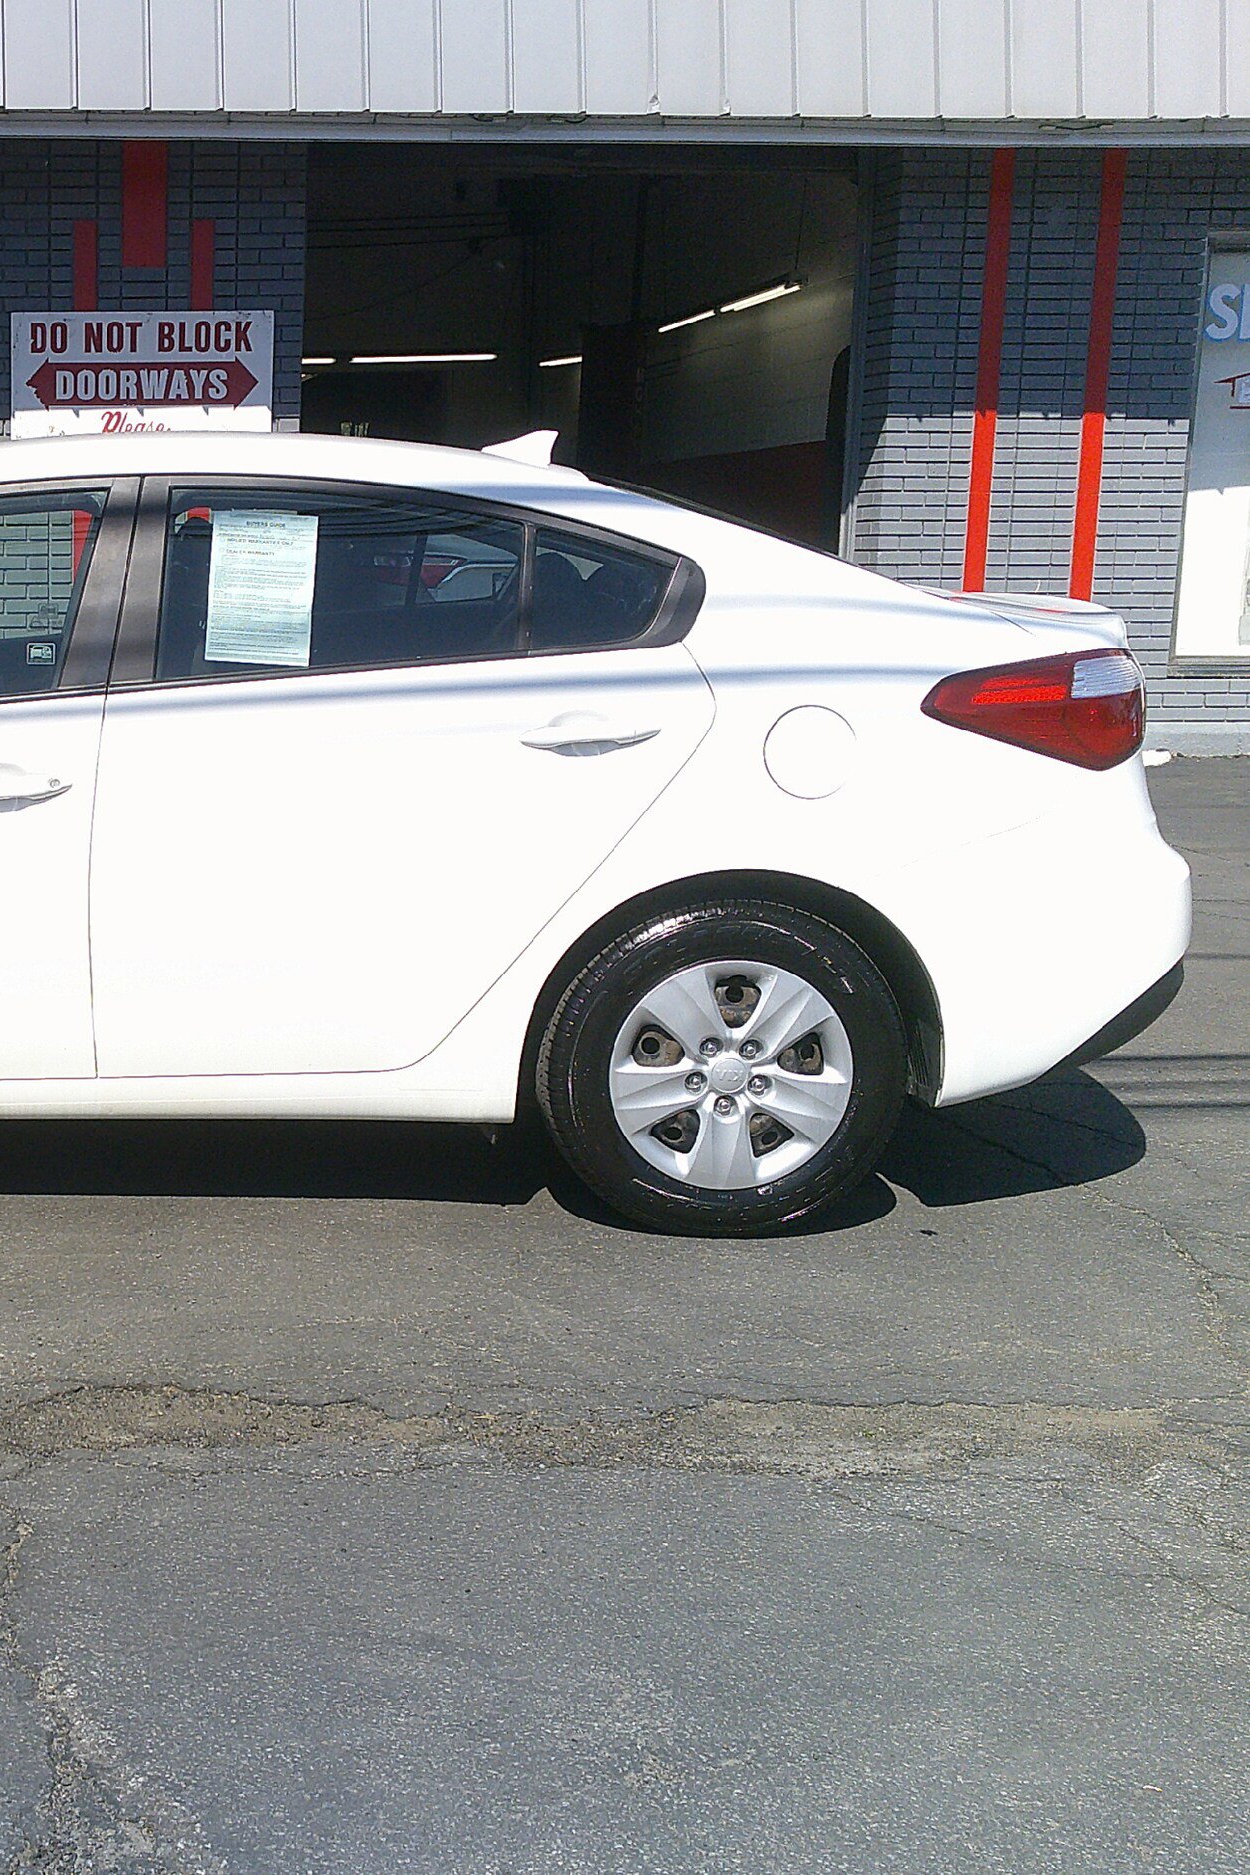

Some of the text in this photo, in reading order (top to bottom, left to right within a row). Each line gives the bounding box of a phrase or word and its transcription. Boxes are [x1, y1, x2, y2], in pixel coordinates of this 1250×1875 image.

[30, 320, 253, 353] DO NOT BLOCK
[55, 368, 228, 401] DOORWAYS
